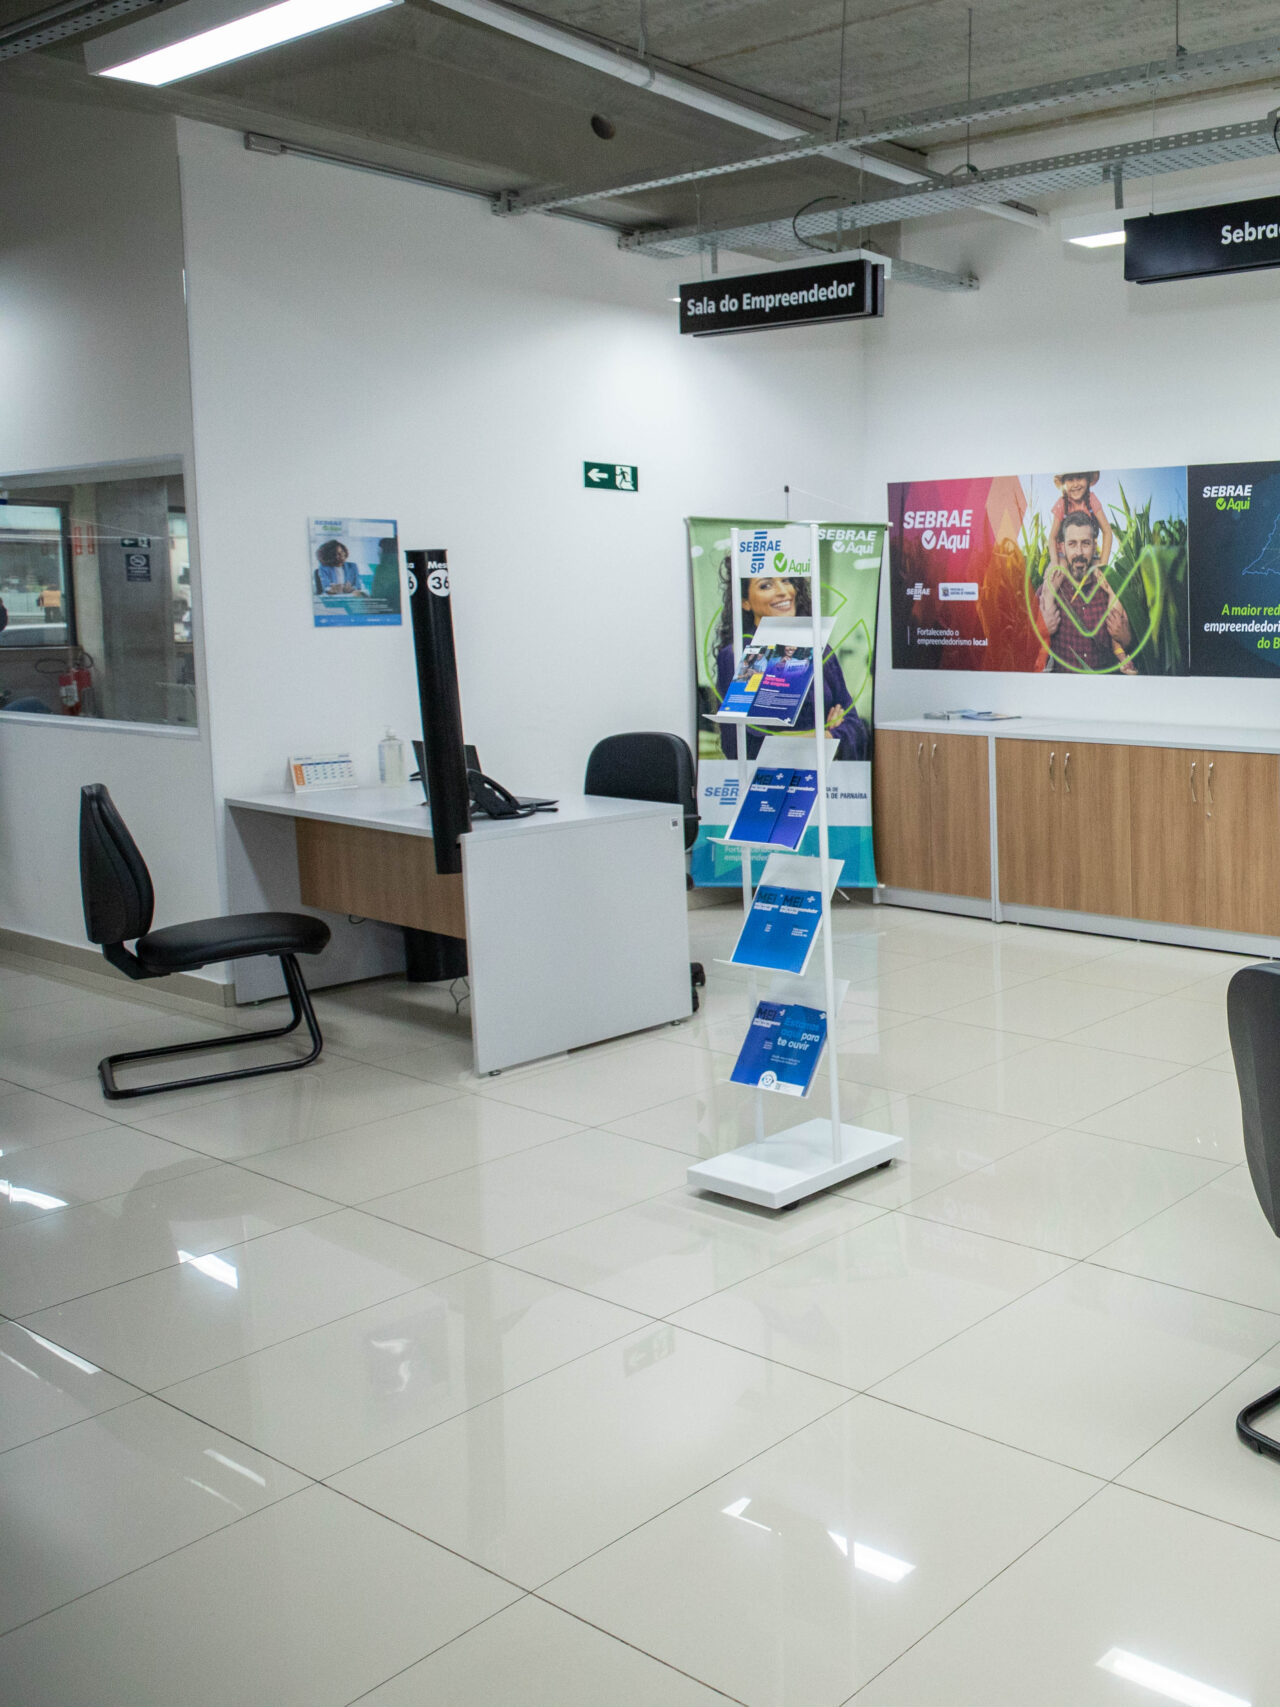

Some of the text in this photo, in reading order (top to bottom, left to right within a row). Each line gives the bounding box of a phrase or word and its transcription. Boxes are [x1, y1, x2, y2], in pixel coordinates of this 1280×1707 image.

[687, 280, 855, 316] Sala do Empreendedor
[1203, 484, 1253, 498] SEBRAE
[1226, 497, 1251, 512] Aqui
[903, 509, 973, 529] SEBRAE
[818, 529, 877, 542] SEBRAE
[936, 530, 971, 553] Aqui
[740, 540, 781, 552] SEBRAE
[845, 542, 874, 555] Aqui
[428, 561, 448, 569] Mes
[750, 563, 765, 574] SP
[788, 559, 811, 575] Aqui
[1221, 603, 1230, 616] A
[1231, 603, 1262, 616] maior
[917, 627, 954, 637] Fortalecendo
[917, 637, 989, 646] empreendedorismo local
[1257, 637, 1271, 649] do
[704, 787, 739, 797] SEBR
[777, 1036, 787, 1046] te
[788, 1041, 810, 1051] ouvir
[801, 1032, 820, 1042] para
